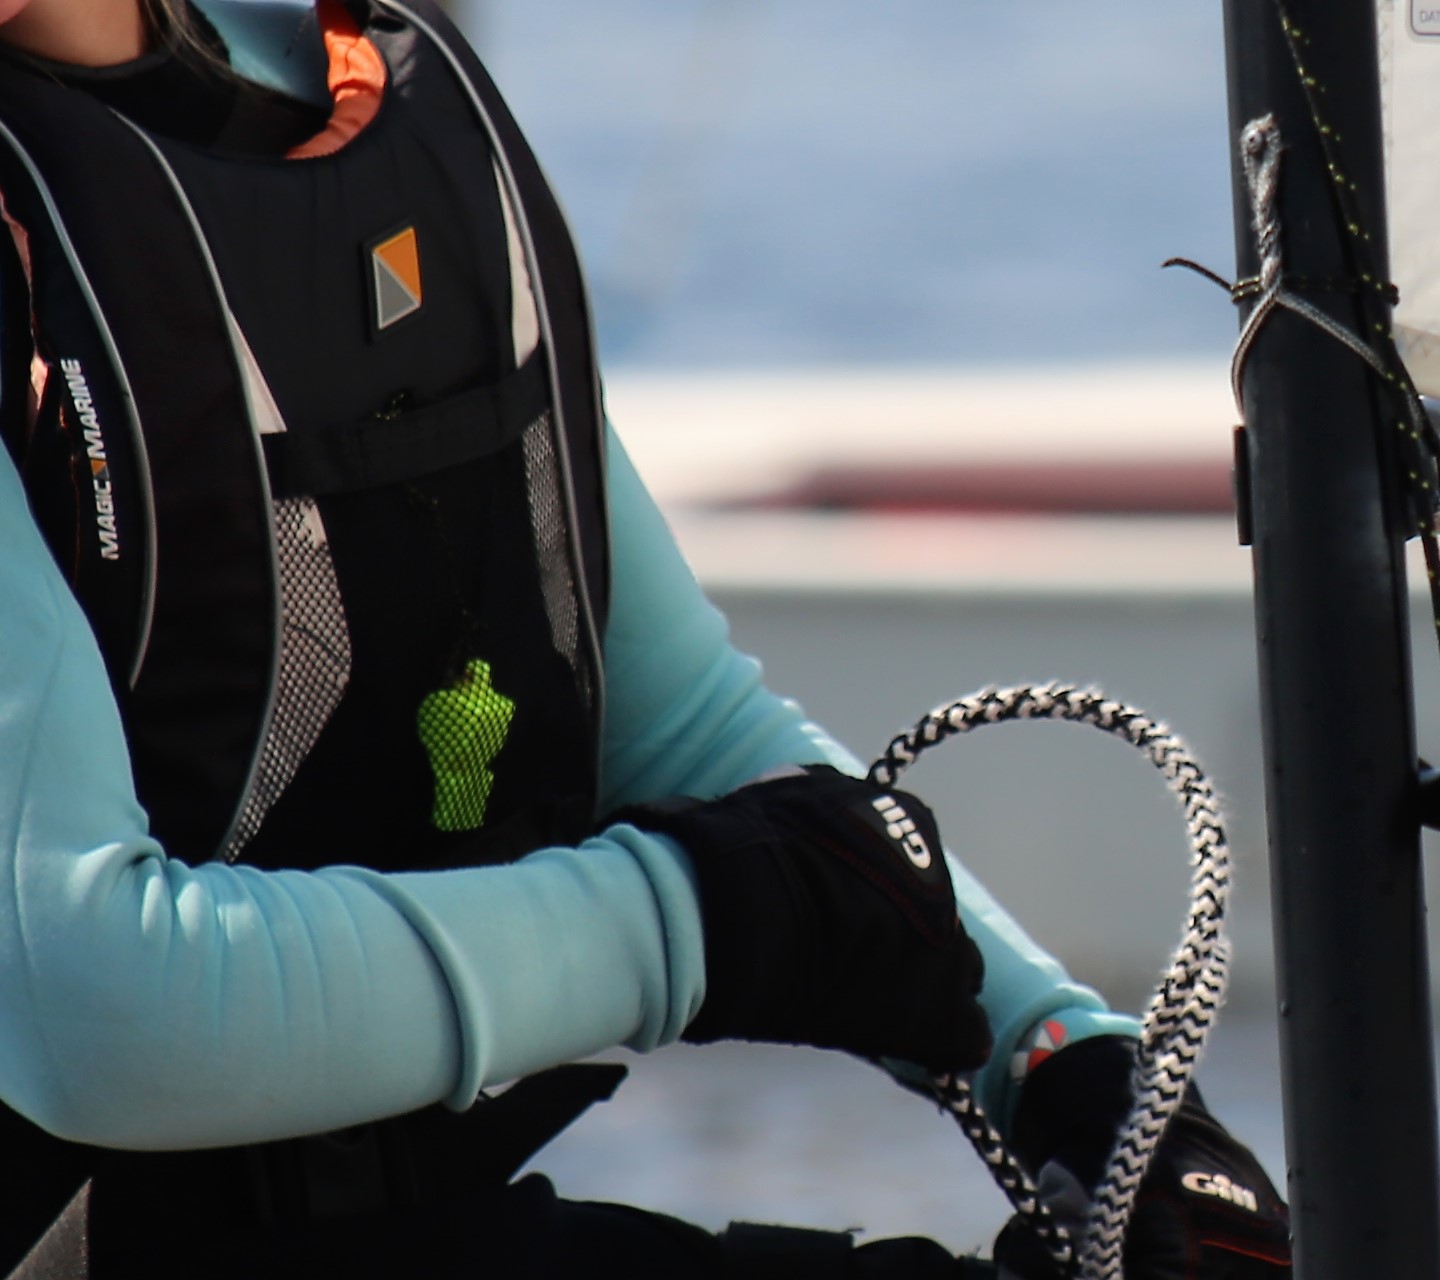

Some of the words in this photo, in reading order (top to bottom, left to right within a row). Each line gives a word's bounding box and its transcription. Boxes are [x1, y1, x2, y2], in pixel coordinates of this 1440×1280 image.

[60, 357, 107, 460] MARINE
[93, 478, 120, 561] MAGIC
[871, 794, 932, 870] Gill
[1180, 1170, 1258, 1213] Gill
